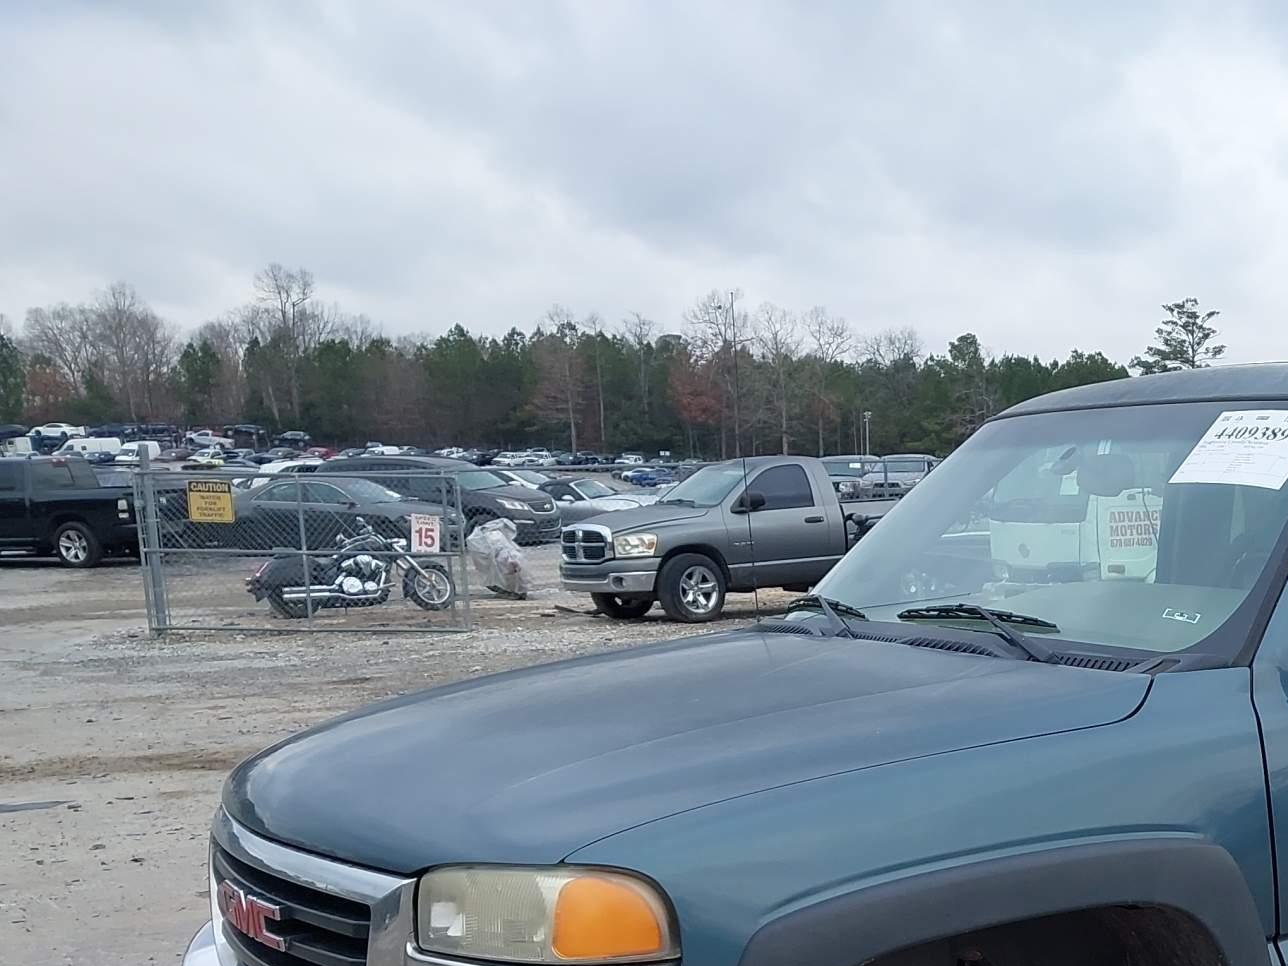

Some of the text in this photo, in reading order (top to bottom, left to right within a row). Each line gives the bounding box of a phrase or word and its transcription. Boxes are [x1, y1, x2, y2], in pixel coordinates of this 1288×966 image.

[190, 482, 229, 492] CAUTION
[415, 527, 435, 548] 15
[1110, 524, 1159, 537] MOTORS
[217, 879, 286, 953] GMC
